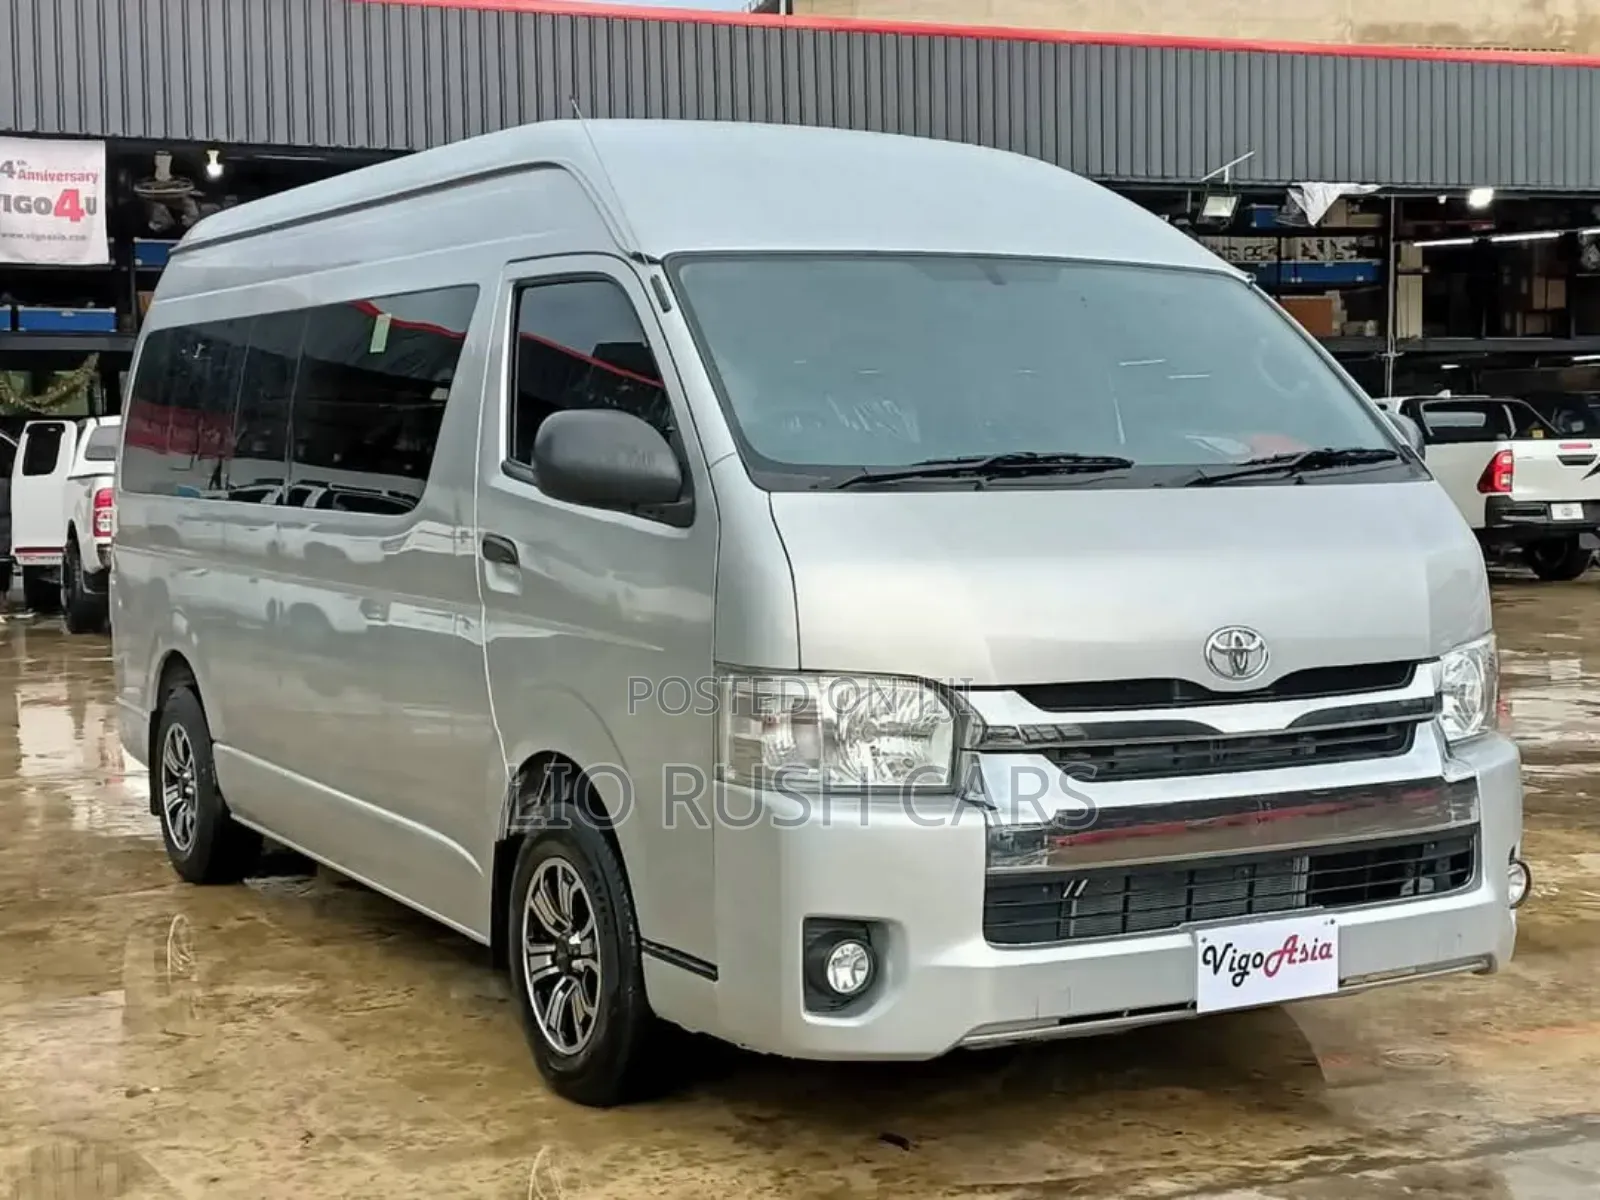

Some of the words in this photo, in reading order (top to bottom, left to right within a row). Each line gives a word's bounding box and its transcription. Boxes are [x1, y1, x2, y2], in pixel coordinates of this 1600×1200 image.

[18, 170, 98, 184] Anniversary
[0, 188, 97, 222] IGO4U
[1202, 934, 1333, 987] VigoAsia
